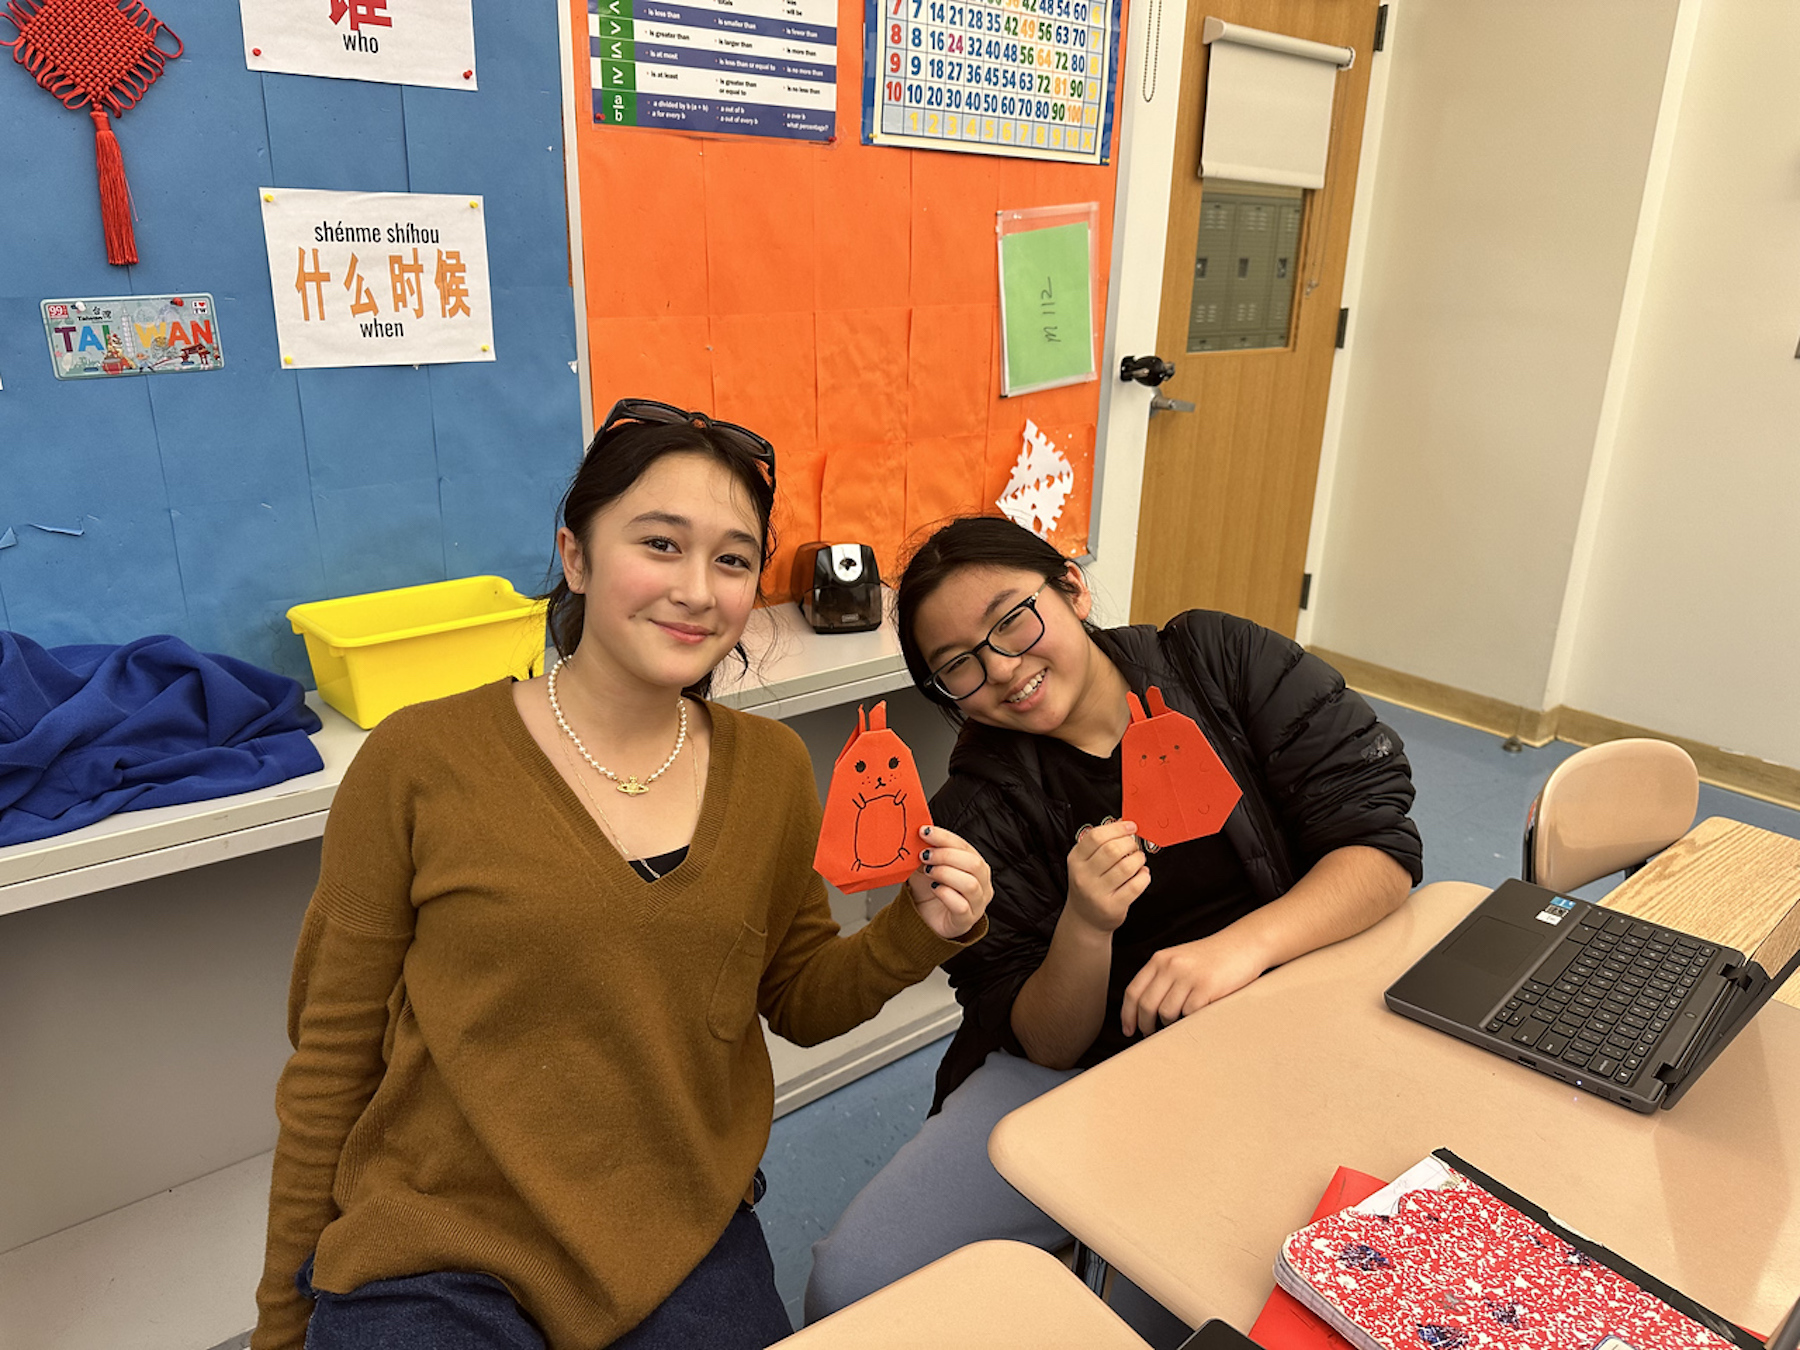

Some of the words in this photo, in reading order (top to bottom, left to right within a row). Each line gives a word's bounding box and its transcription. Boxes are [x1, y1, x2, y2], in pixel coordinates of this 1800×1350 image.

[667, 10, 680, 19] than
[1040, 0, 1053, 14] 48
[1057, 0, 1070, 18] 54
[1074, 3, 1086, 22] 60
[1092, 6, 1100, 24] 6
[656, 31, 675, 40] greater
[724, 20, 743, 28] smaller
[744, 22, 756, 30] than
[913, 0, 922, 18] 7
[930, 2, 944, 22] 14
[950, 6, 963, 26] 21
[968, 9, 982, 30] 28
[987, 12, 1000, 32] 35
[1004, 16, 1018, 36] 42
[1021, 19, 1034, 39] 49
[1038, 22, 1052, 42] 56
[1056, 26, 1068, 44] 63
[1073, 28, 1085, 47] 70
[1092, 32, 1100, 49] 7
[342, 30, 378, 54] who
[891, 24, 902, 44] 8
[912, 28, 922, 47] 8
[930, 30, 944, 50] 16
[948, 34, 963, 54] 24
[968, 36, 982, 56] 32
[986, 40, 1000, 60] 40
[1004, 44, 1017, 62] 48
[1020, 46, 1034, 64] 56
[1038, 48, 1052, 68] 64
[1056, 52, 1068, 70] 72
[1072, 54, 1084, 72] 80
[1090, 56, 1098, 74] 8
[756, 62, 769, 70] equal
[890, 52, 900, 73] 9
[912, 56, 920, 75] 9
[930, 58, 943, 78] 18
[948, 62, 962, 80] 27
[967, 64, 981, 84] 36
[985, 67, 998, 86] 45
[1002, 69, 1015, 88] 54
[1020, 72, 1032, 90] 63
[1038, 75, 1050, 93] 72
[1054, 77, 1066, 96] 81
[1070, 80, 1082, 98] 90
[1088, 82, 1097, 100] 9
[614, 95, 622, 104] a
[658, 100, 678, 109] divided
[886, 82, 902, 102] 10
[908, 84, 922, 104] 10
[927, 86, 942, 106] 20
[946, 89, 962, 108] 30
[966, 92, 980, 111] 40
[984, 94, 997, 112] 50
[1002, 96, 1014, 115] 60
[1018, 99, 1032, 116] 70
[1036, 101, 1049, 119] 80
[1052, 103, 1064, 120] 90
[1068, 105, 1082, 123] 100
[1084, 106, 1096, 125] 10
[615, 109, 622, 121] b
[910, 112, 918, 132] 1
[928, 114, 938, 134] 2
[948, 116, 957, 135] 3
[966, 118, 976, 136] 4
[985, 120, 994, 138] 5
[1002, 122, 1012, 141] 6
[1020, 124, 1028, 142] 7
[1036, 126, 1045, 144] 8
[1052, 128, 1060, 146] 9
[1067, 130, 1078, 148] 10
[314, 221, 381, 242] shénme
[386, 222, 440, 244] shíhou
[295, 246, 471, 321] 什么时候
[360, 318, 404, 338] when
